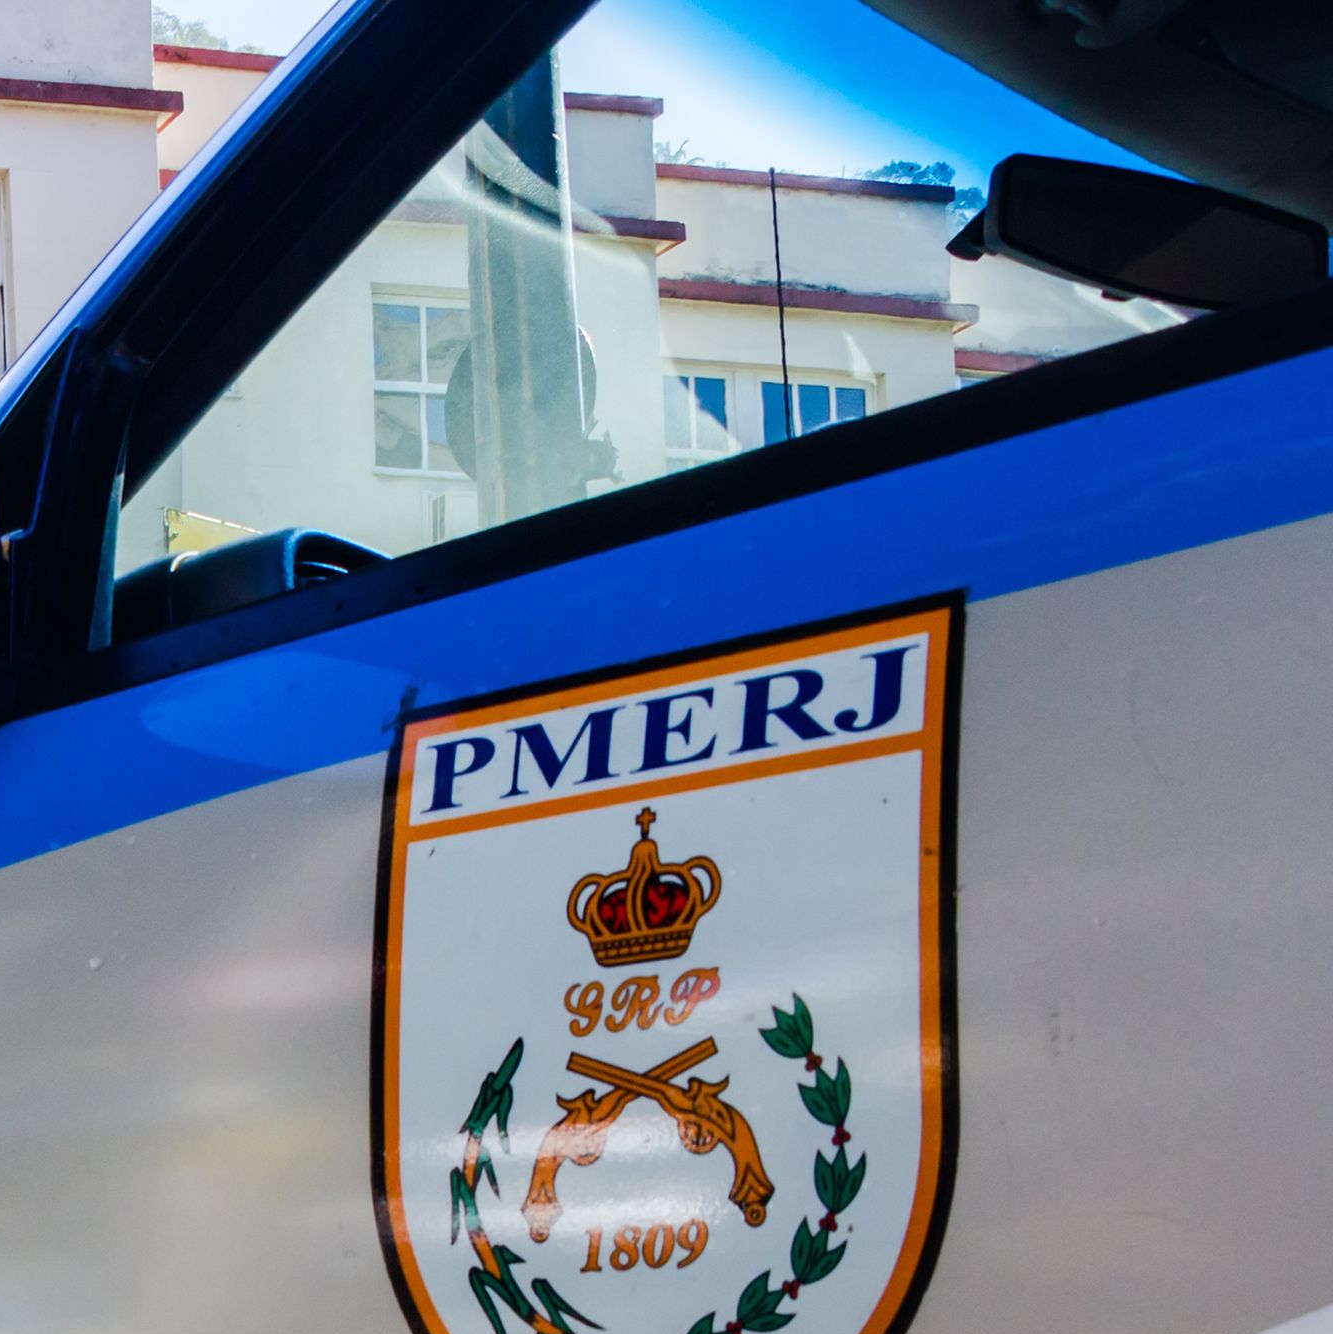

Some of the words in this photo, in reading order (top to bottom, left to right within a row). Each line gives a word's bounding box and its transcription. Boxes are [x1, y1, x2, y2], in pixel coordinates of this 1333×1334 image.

[420, 644, 921, 814] PMERJ
[563, 966, 721, 1038] GRP
[580, 1218, 710, 1275] 1809
